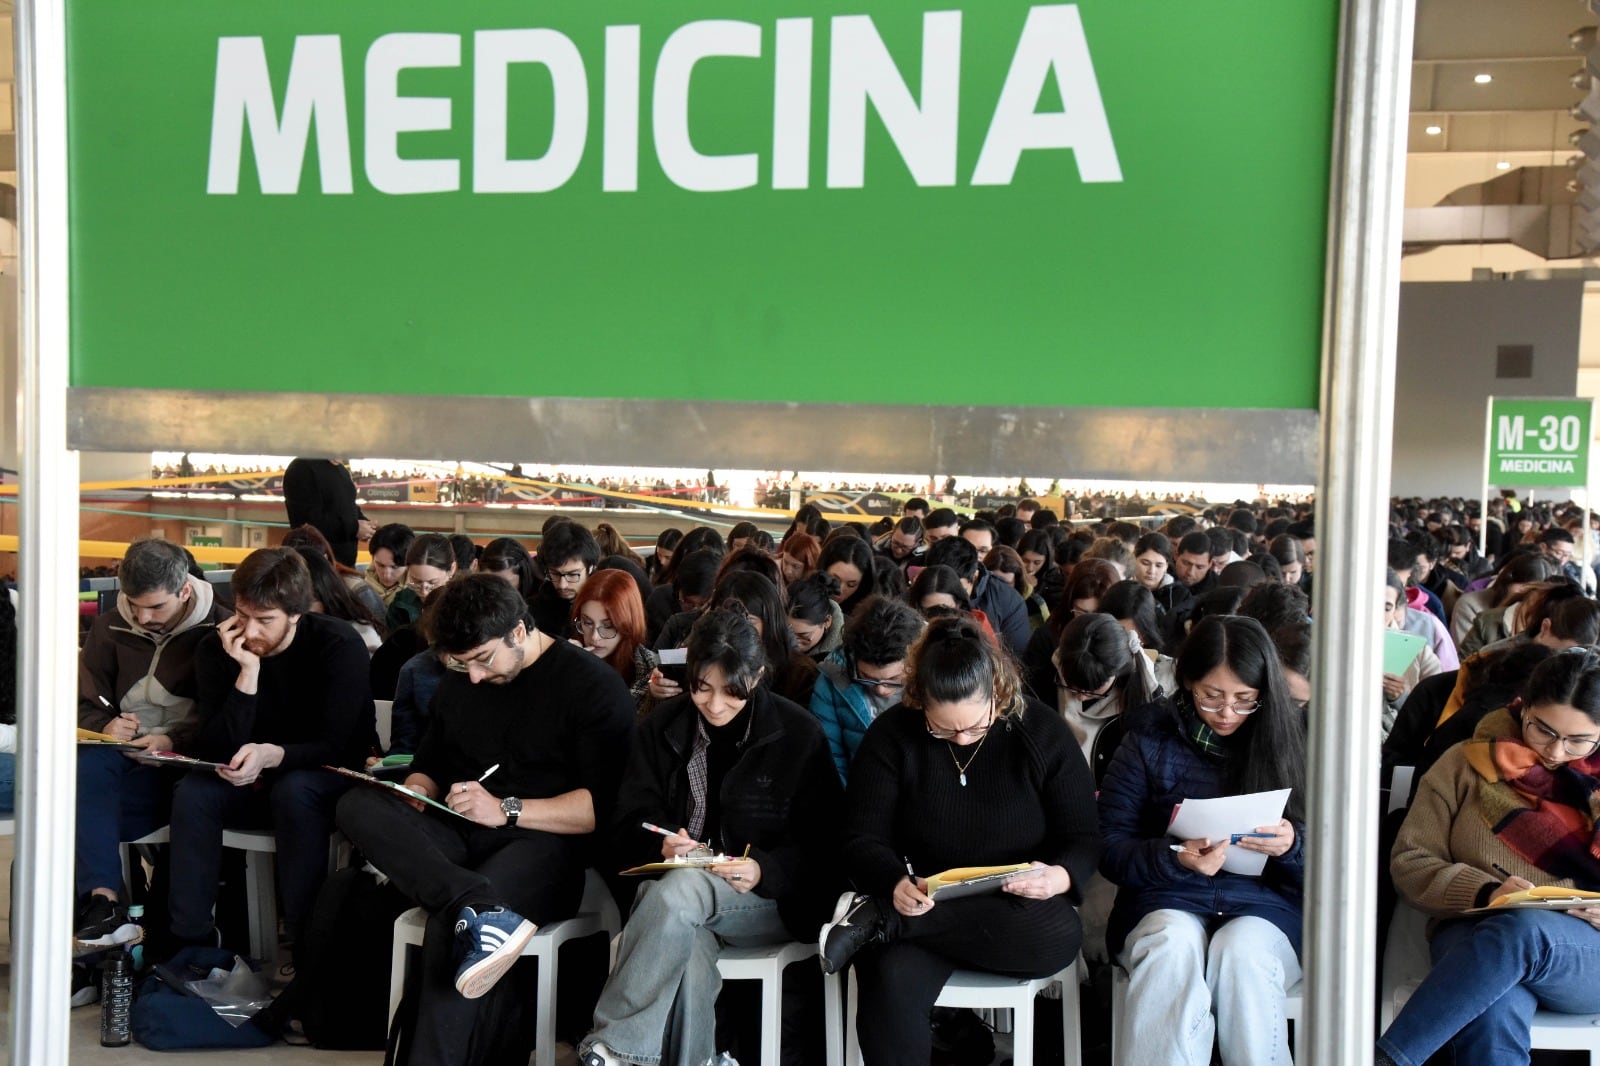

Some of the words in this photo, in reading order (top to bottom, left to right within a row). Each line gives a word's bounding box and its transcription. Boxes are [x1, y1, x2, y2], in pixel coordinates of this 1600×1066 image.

[207, 4, 1123, 195] MEDICINA
[1497, 415, 1581, 452] M-30
[1500, 459, 1575, 474] MEDICINA
